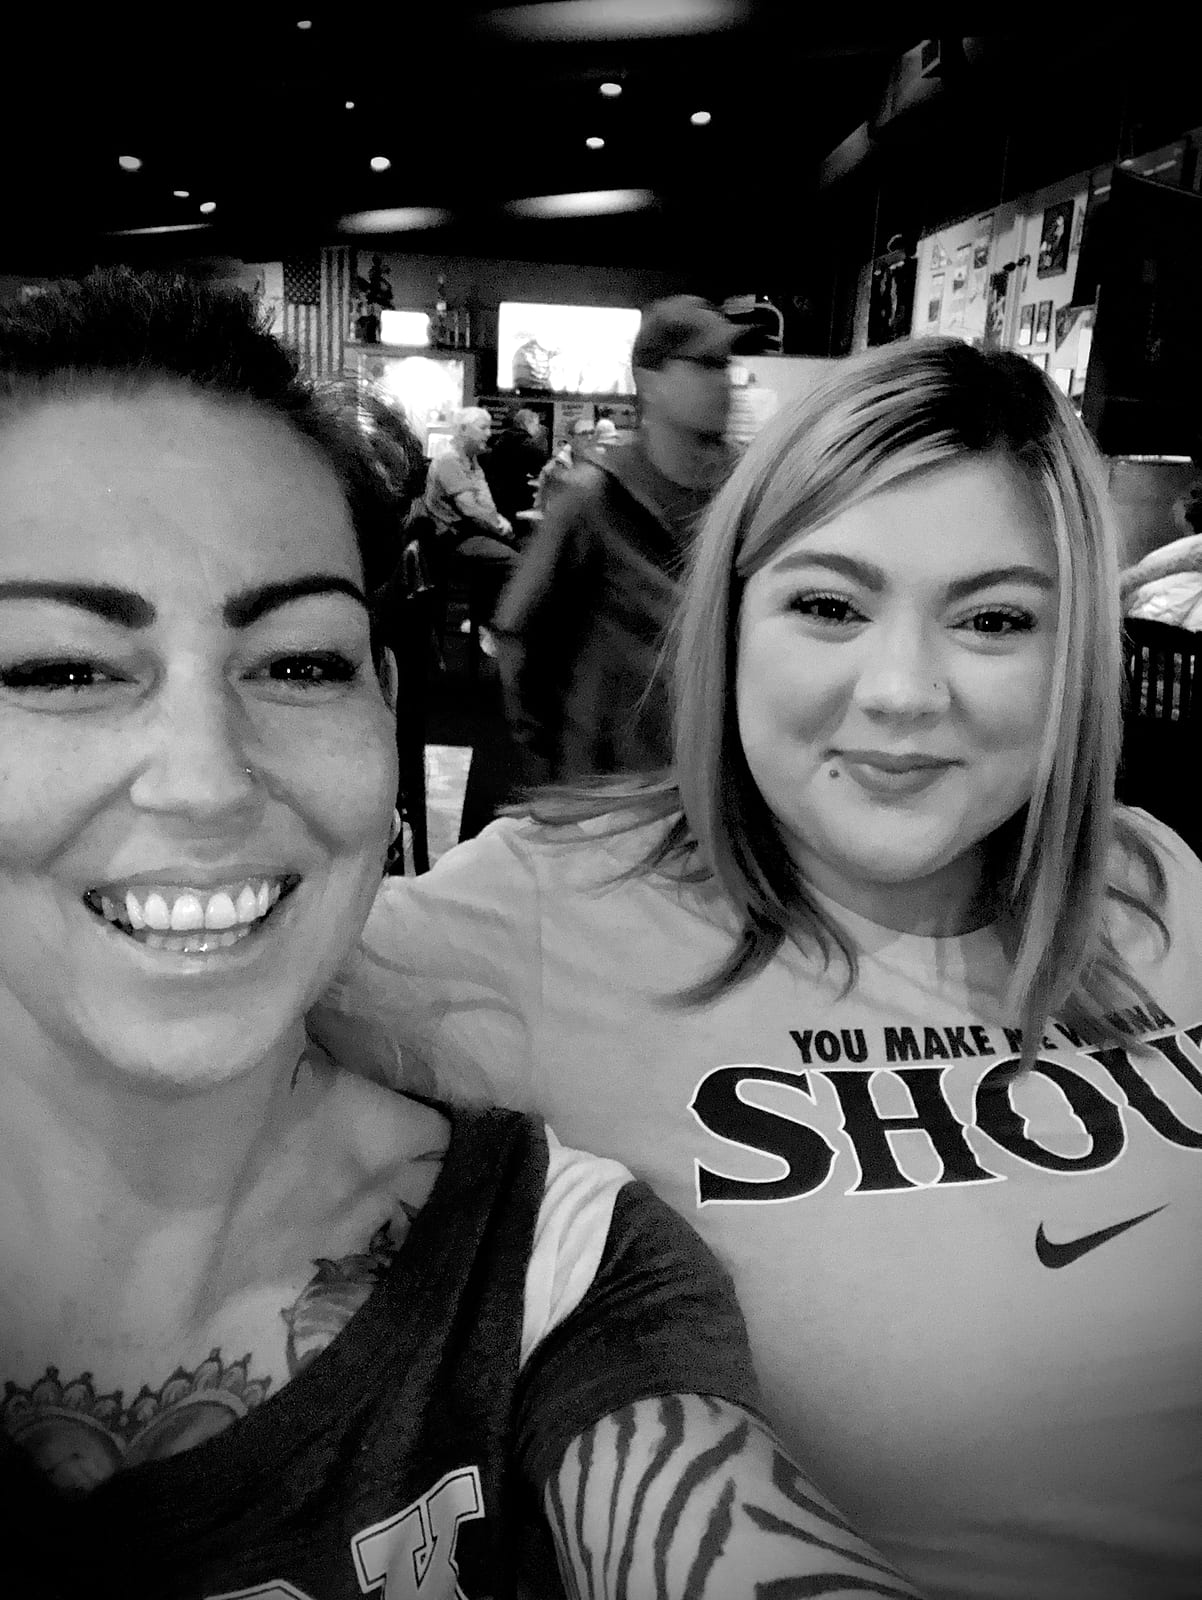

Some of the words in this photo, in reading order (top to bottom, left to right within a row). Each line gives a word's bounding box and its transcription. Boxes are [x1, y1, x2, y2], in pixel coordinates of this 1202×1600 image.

[789, 1028, 868, 1064] YOU
[883, 1025, 996, 1062] MAKE
[687, 1022, 1202, 1208] SHOU
